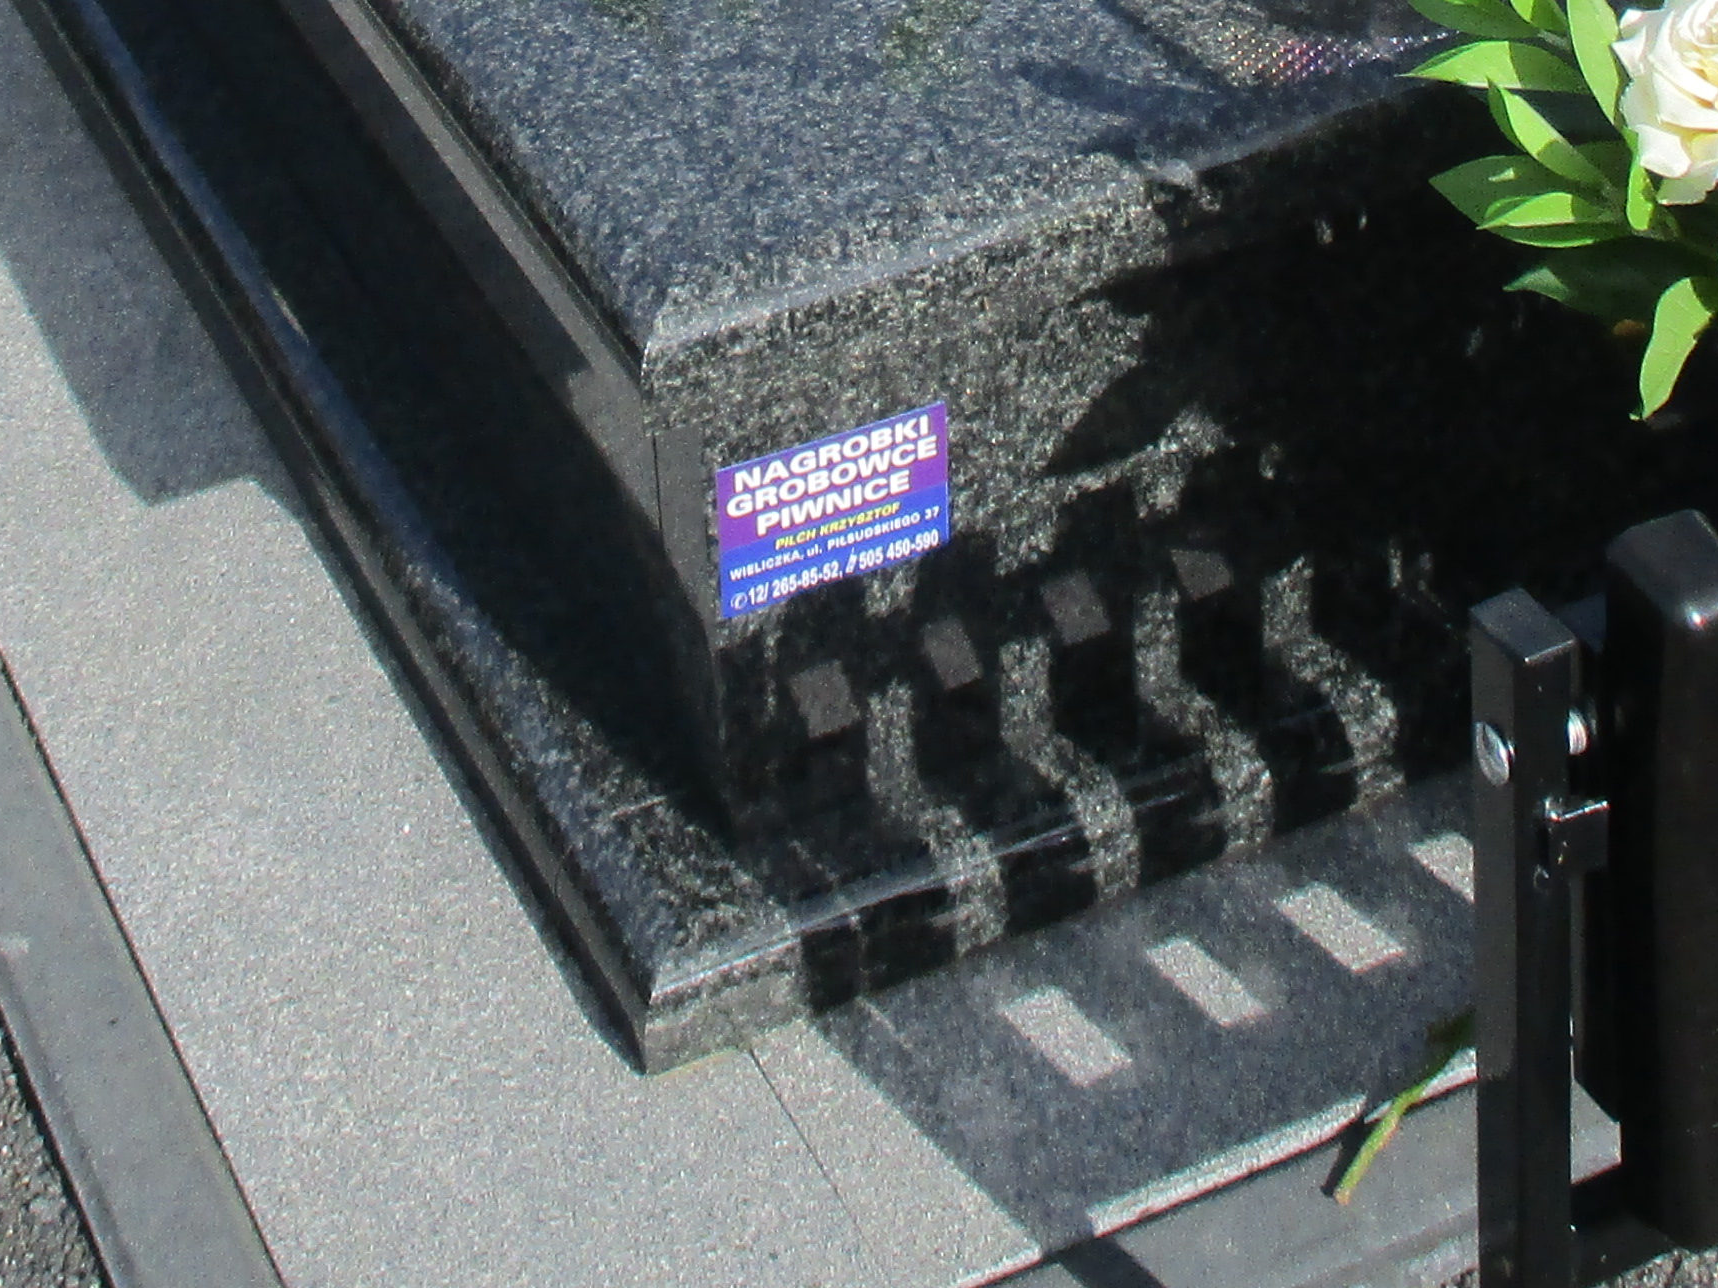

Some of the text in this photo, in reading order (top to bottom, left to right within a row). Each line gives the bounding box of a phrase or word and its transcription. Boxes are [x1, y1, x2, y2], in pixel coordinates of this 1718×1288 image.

[726, 435, 938, 518] GROBOWCE
[733, 414, 930, 493] NAGROBKI
[756, 469, 911, 537] PIWNICE
[774, 502, 901, 550] PILCH KRZYSZTOF
[729, 549, 804, 581] WIELICZKA,
[806, 544, 823, 559] ul.
[924, 507, 940, 521] 37
[858, 548, 884, 571] 505
[886, 529, 939, 562] 450-590
